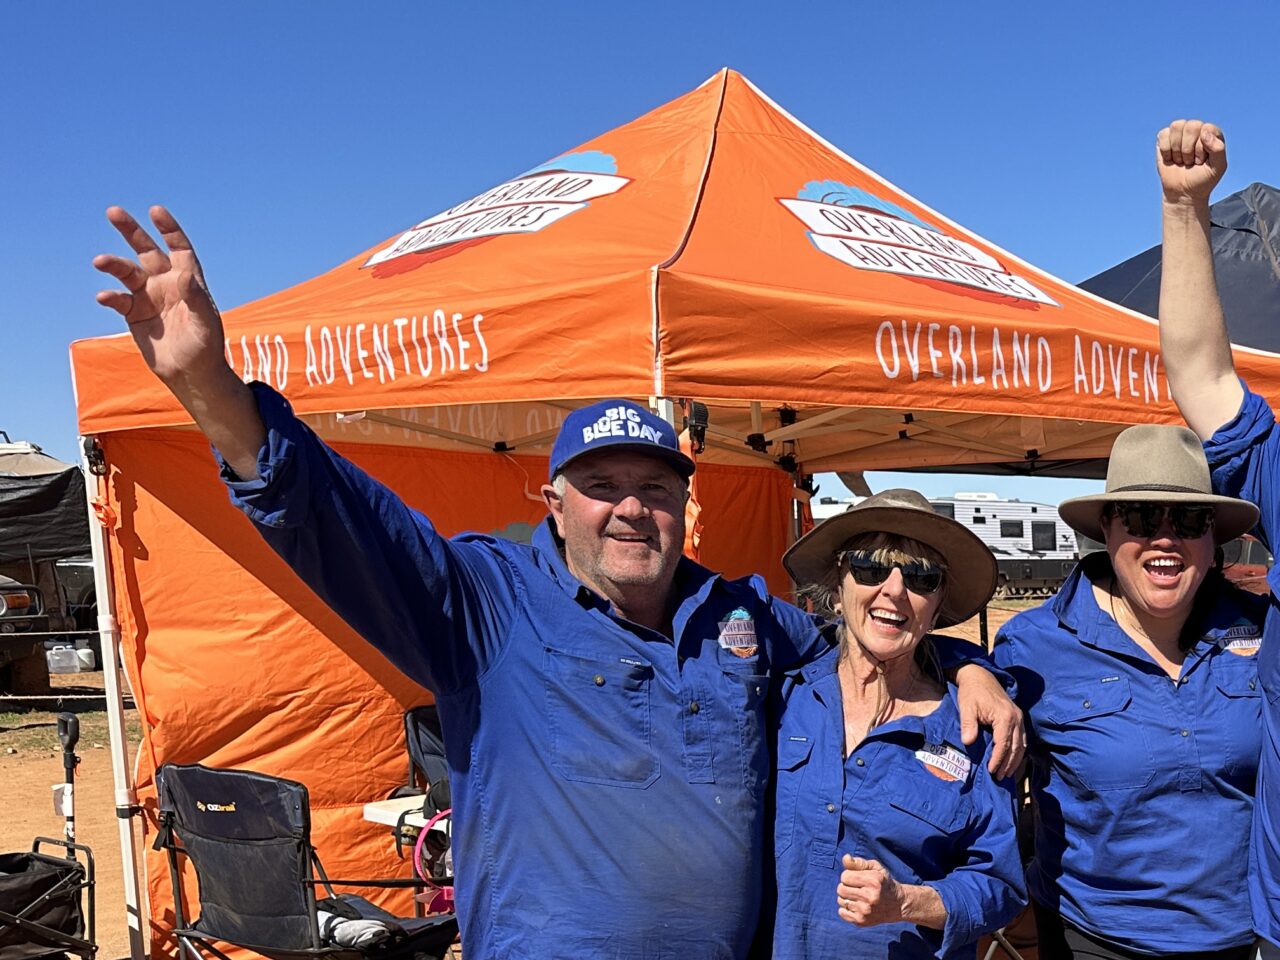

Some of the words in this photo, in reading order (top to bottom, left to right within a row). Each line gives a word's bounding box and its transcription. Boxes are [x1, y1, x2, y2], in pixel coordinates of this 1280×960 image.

[385, 205, 561, 256] ADVENTURES
[819, 208, 978, 261] OVERLAND
[839, 240, 1037, 297] ADVENTURES
[305, 310, 489, 387] ADVENTURES
[875, 319, 1052, 393] OVERLAND
[1074, 335, 1171, 403] ADVEN
[582, 416, 625, 444] BLUE
[627, 421, 663, 445] DAY
[605, 406, 641, 422] BIG
[929, 743, 966, 767] OVERLAND
